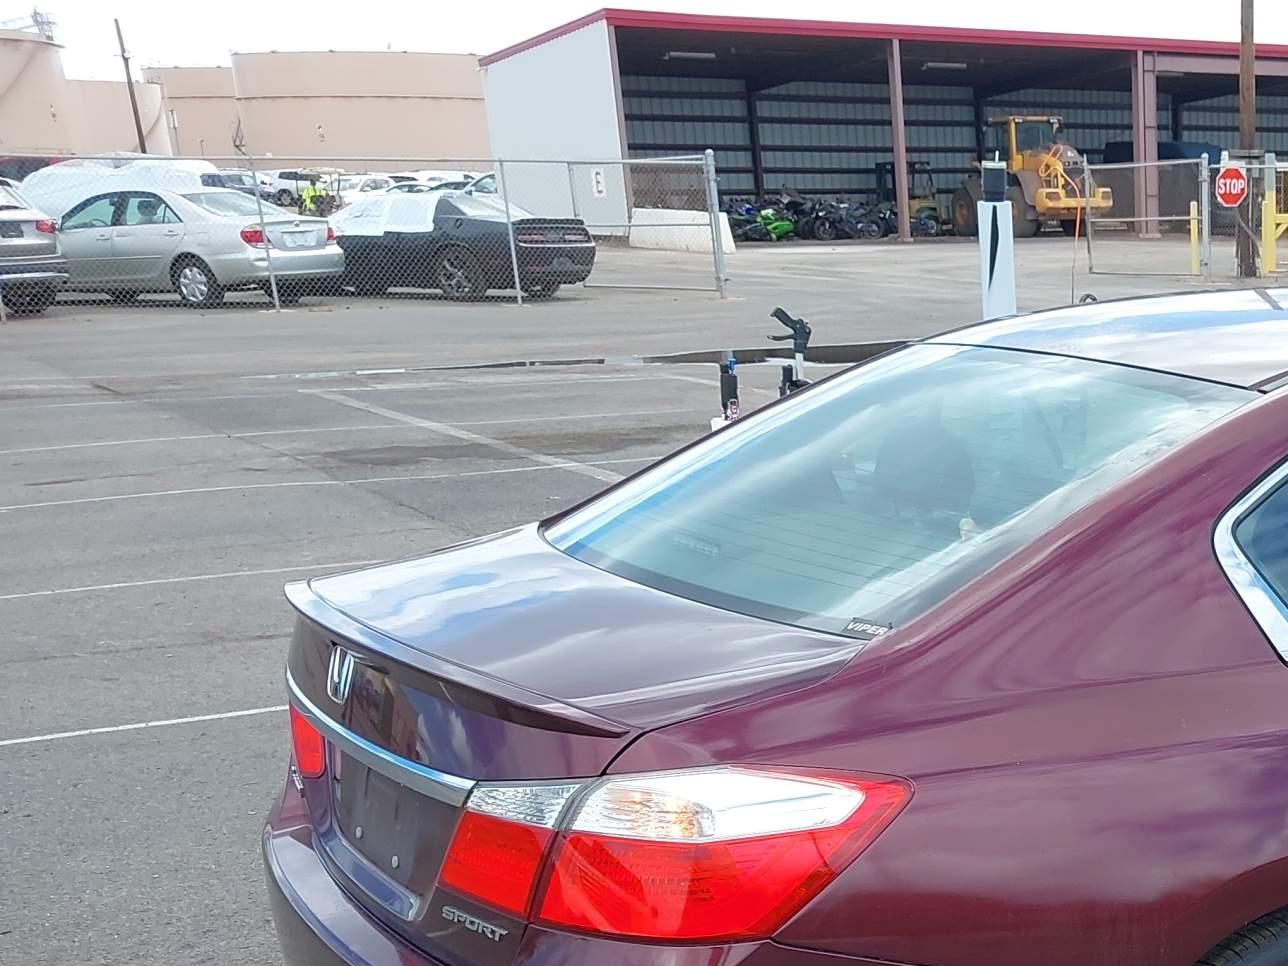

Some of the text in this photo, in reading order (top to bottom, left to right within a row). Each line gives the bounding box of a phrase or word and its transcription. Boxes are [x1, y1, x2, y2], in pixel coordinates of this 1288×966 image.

[1218, 178, 1245, 195] STOP
[846, 621, 889, 635] VIPER
[441, 905, 508, 942] SPORT
